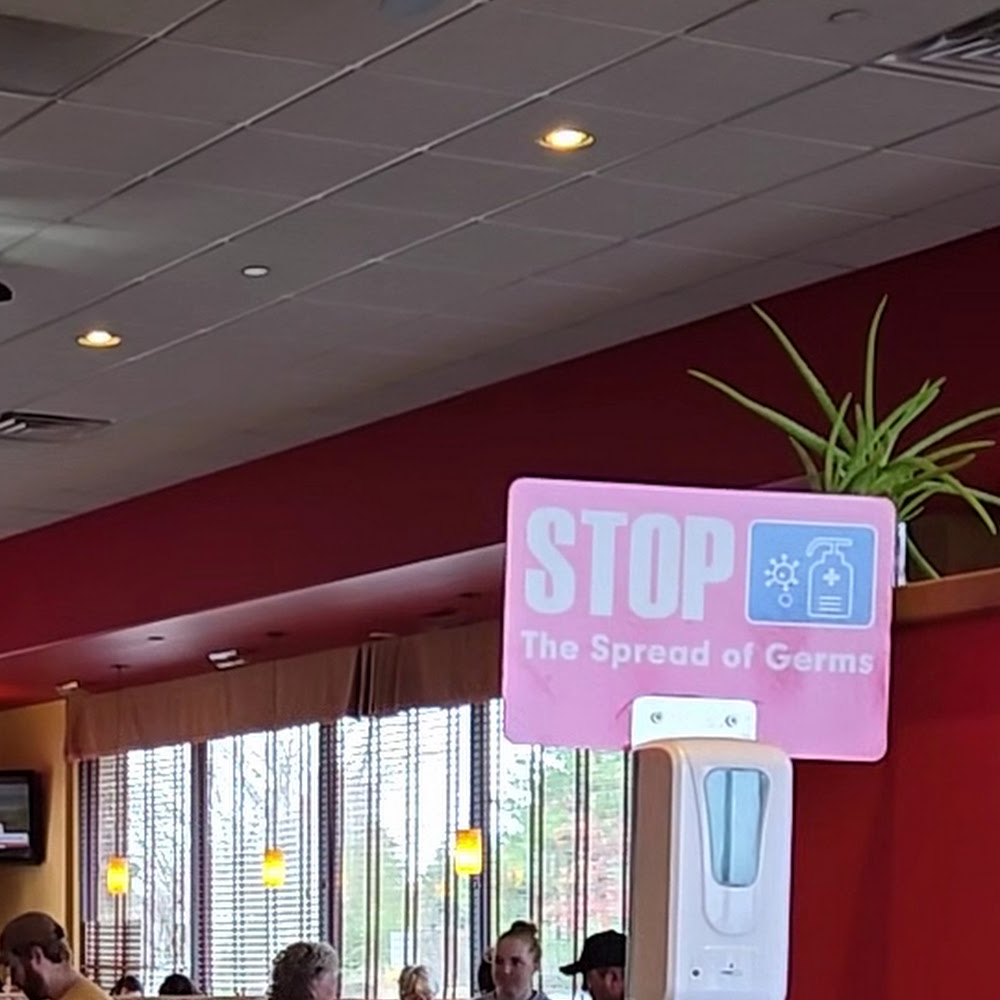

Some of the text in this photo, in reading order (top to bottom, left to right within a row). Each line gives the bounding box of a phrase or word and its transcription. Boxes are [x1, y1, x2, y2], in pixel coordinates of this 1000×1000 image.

[525, 506, 735, 621] STOP
[521, 630, 874, 675] The Spread of Germs
